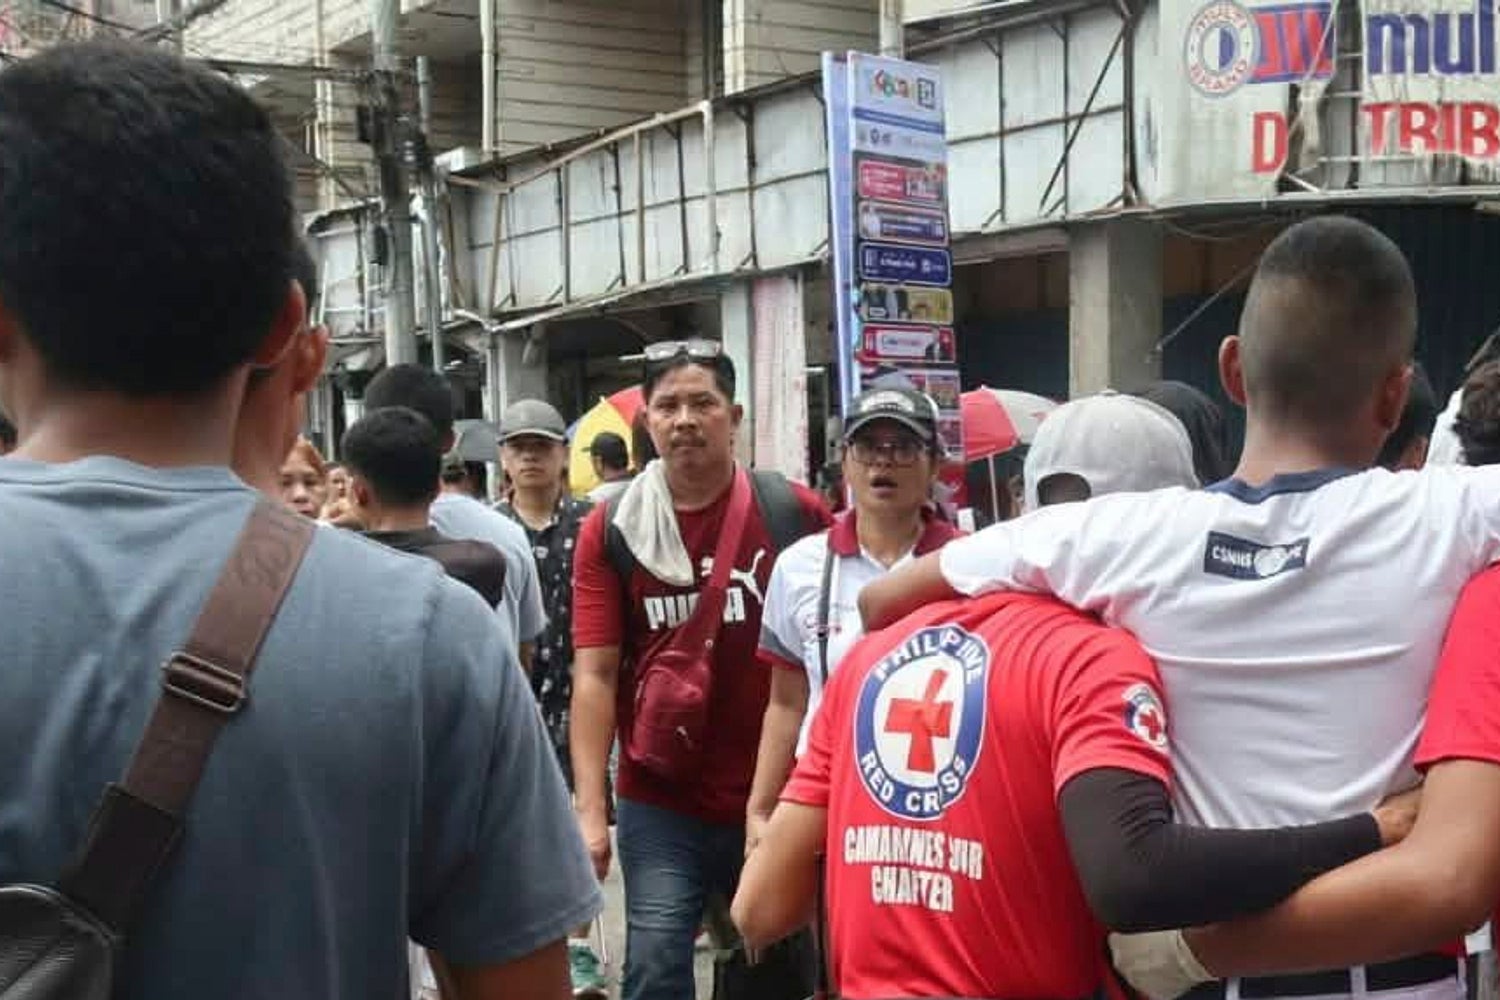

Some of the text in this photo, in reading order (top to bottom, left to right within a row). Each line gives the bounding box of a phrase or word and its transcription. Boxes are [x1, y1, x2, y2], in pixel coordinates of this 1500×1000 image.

[643, 587, 746, 630] PUA
[861, 750, 967, 812] RED CRSS
